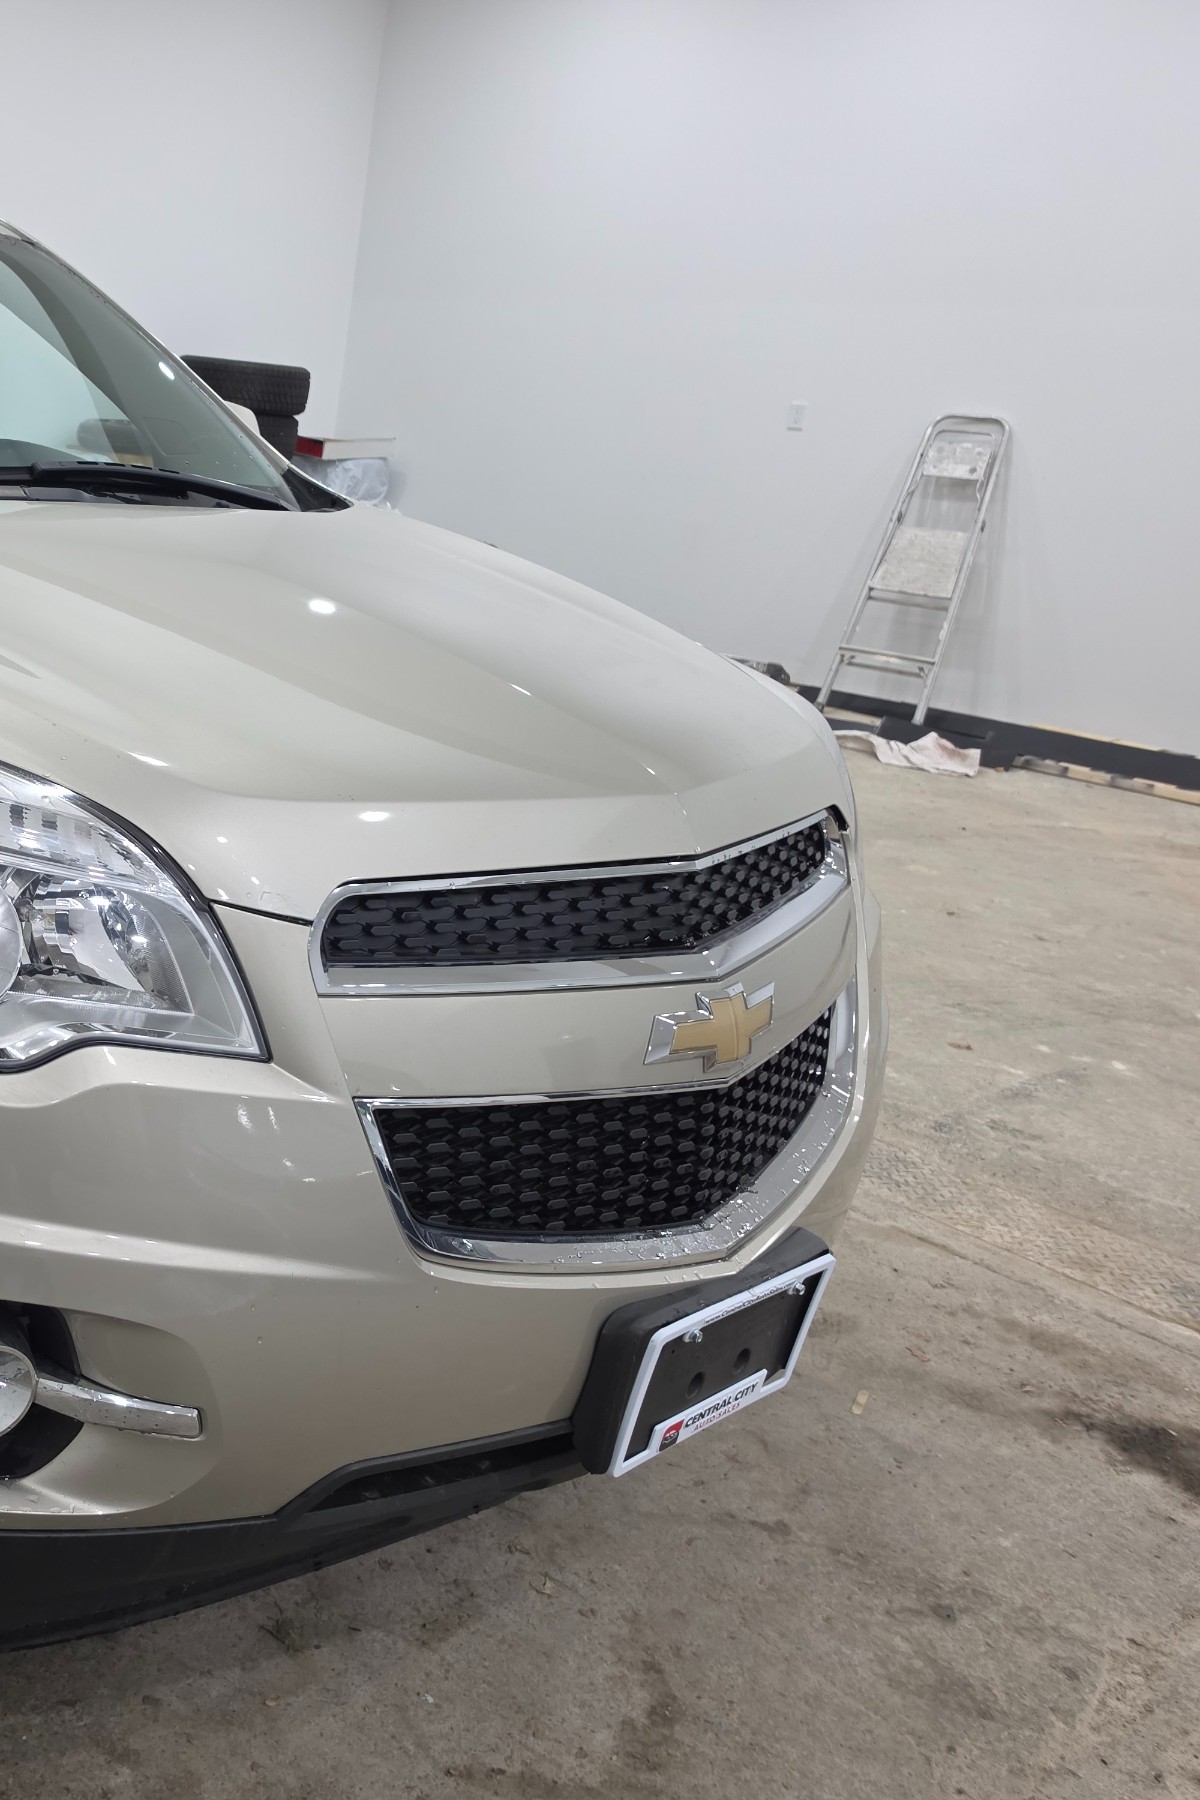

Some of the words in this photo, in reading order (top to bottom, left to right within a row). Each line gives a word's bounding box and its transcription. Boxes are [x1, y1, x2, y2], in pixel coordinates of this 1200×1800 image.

[685, 1396, 732, 1427] CENTRAL
[734, 1382, 758, 1401] CITY
[693, 1416, 716, 1431] AUTO
[718, 1402, 740, 1419] SALES
